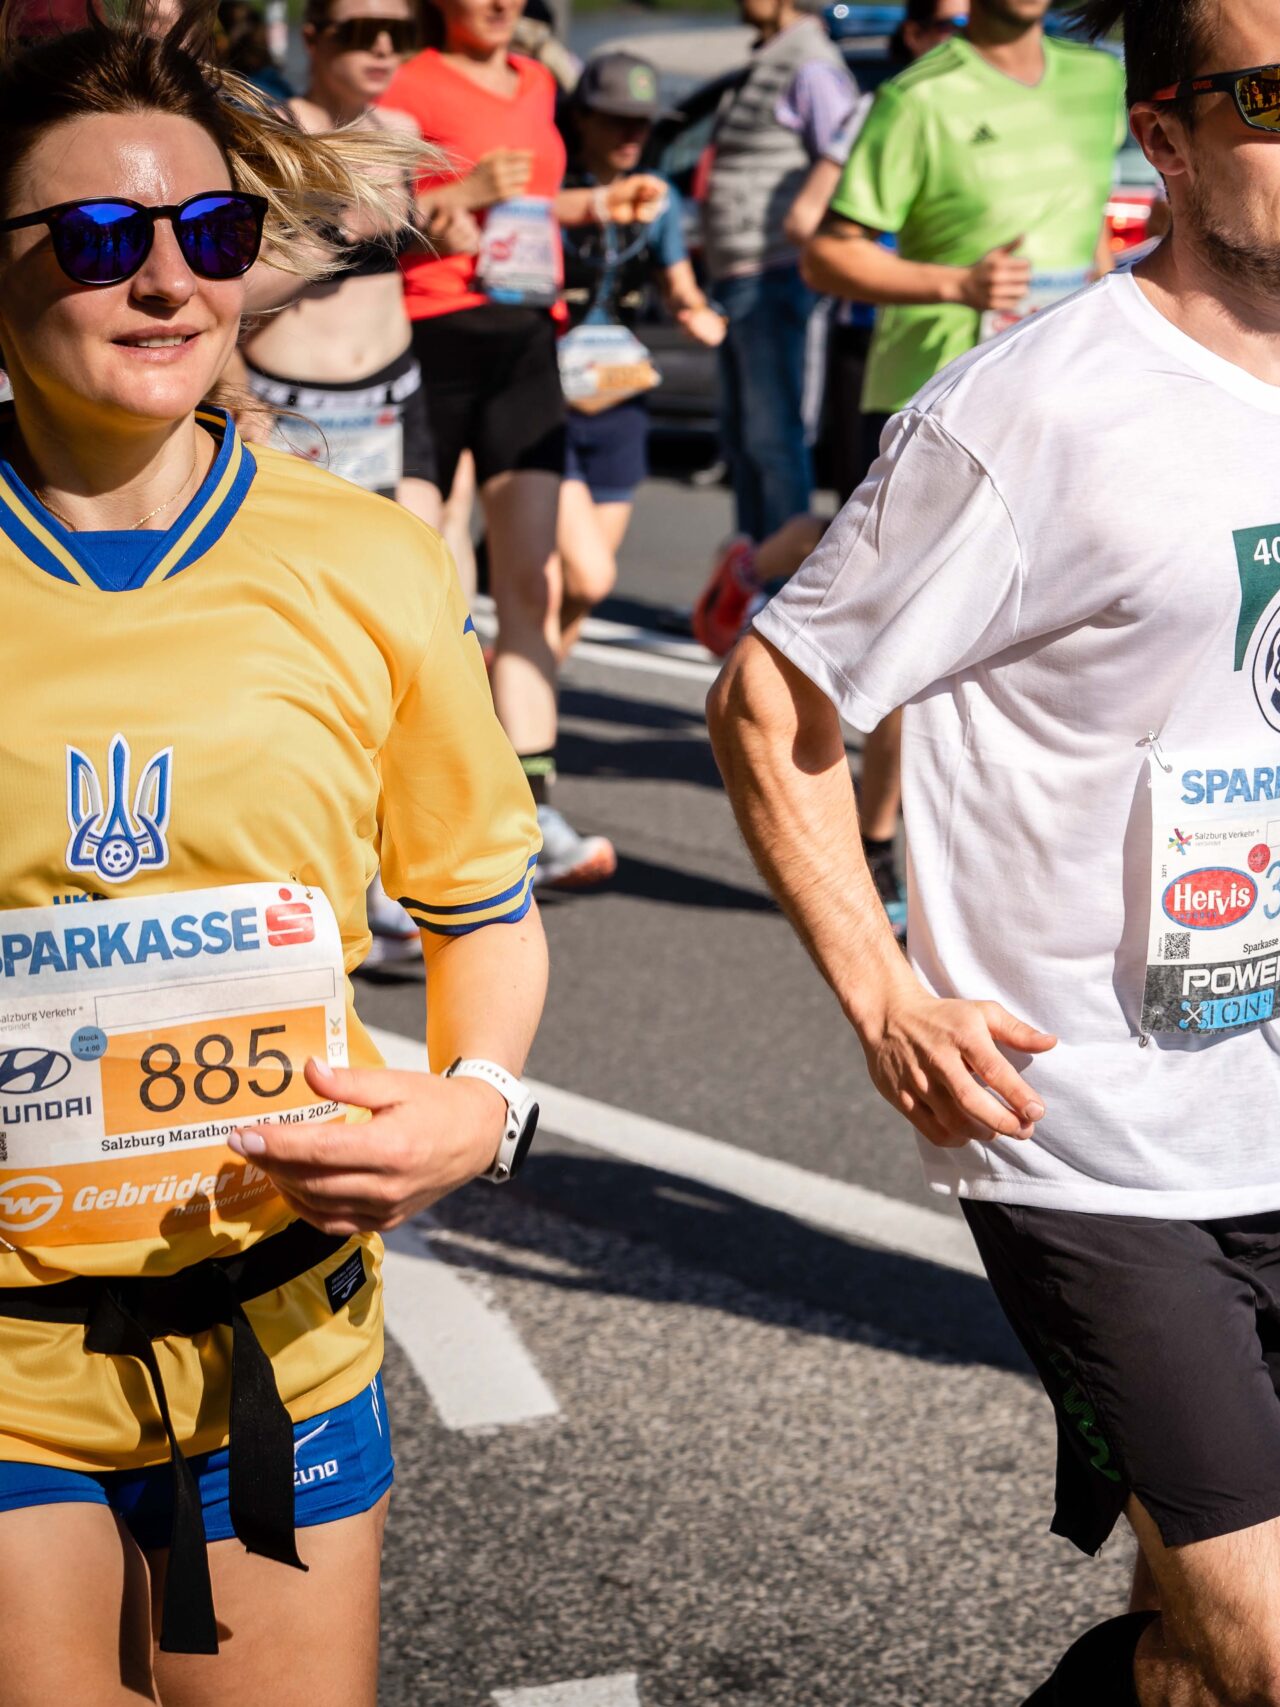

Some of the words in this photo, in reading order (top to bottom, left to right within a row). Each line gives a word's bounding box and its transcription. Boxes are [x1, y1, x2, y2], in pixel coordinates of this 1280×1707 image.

[1194, 832, 1227, 841] Salzburg
[1228, 829, 1256, 839] Verkehr
[1173, 882, 1251, 916] Hervis
[0, 907, 260, 978] PARKASSE
[1242, 938, 1279, 954] Sparkasse
[0, 1010, 38, 1024] alzburg
[38, 1005, 78, 1020] Verkehr
[0, 1022, 31, 1033] erbindet
[78, 1034, 99, 1042] Block
[139, 1024, 293, 1113] 885
[0, 1096, 92, 1125] UNDAI
[101, 1133, 166, 1152] Salzburg
[169, 1123, 239, 1144] Marathon
[279, 1112, 305, 1126] Mai
[308, 1103, 340, 1120] 2022
[72, 1171, 236, 1213] Gebrüder
[173, 1194, 239, 1218] Transport
